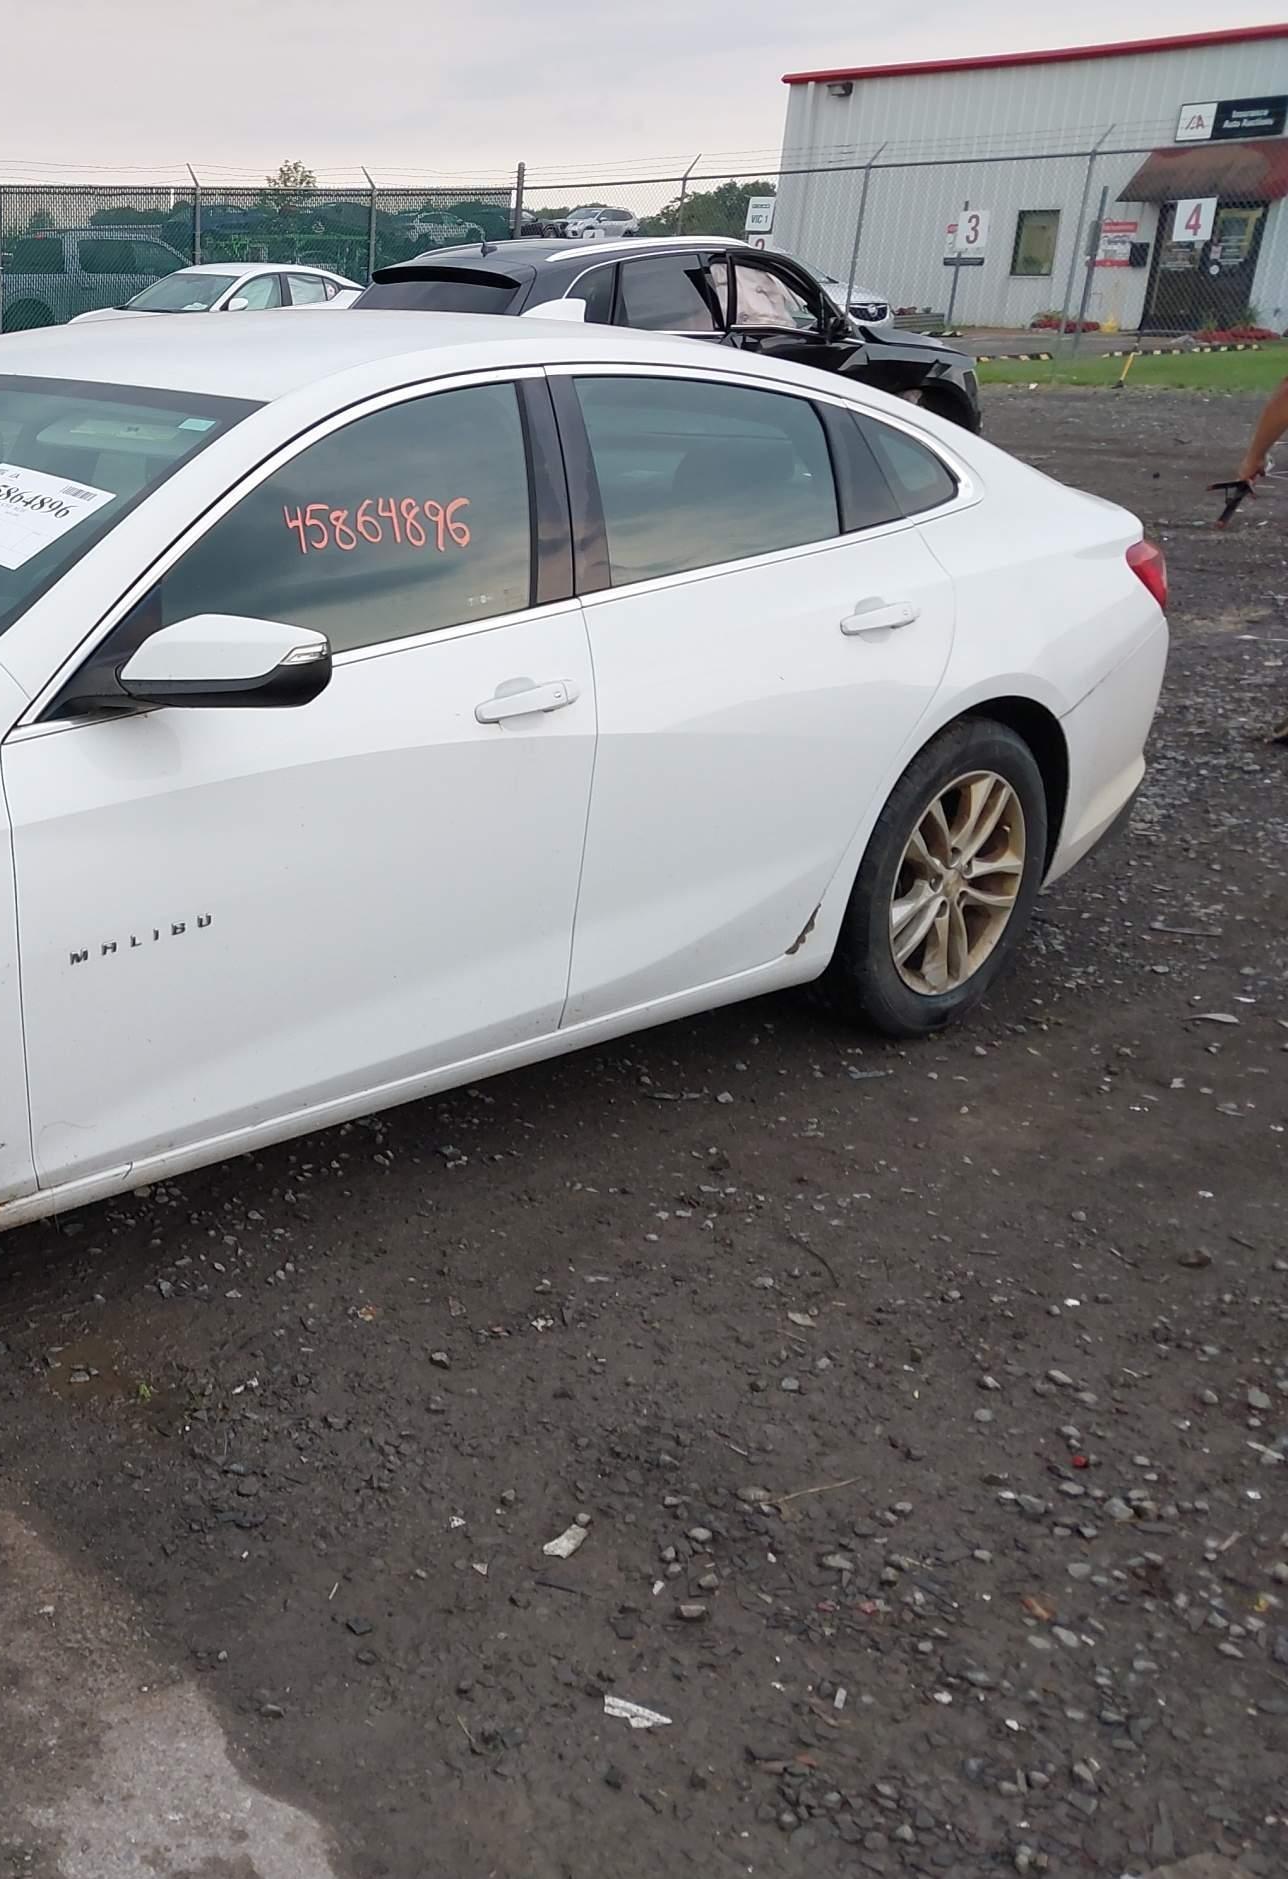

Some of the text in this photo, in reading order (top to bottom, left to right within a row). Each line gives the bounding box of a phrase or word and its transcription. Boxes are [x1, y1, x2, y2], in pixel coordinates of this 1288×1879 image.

[965, 214, 980, 244] 3
[1185, 203, 1202, 236] 4
[283, 497, 471, 554] 45864896
[70, 913, 212, 965] MALIBU
